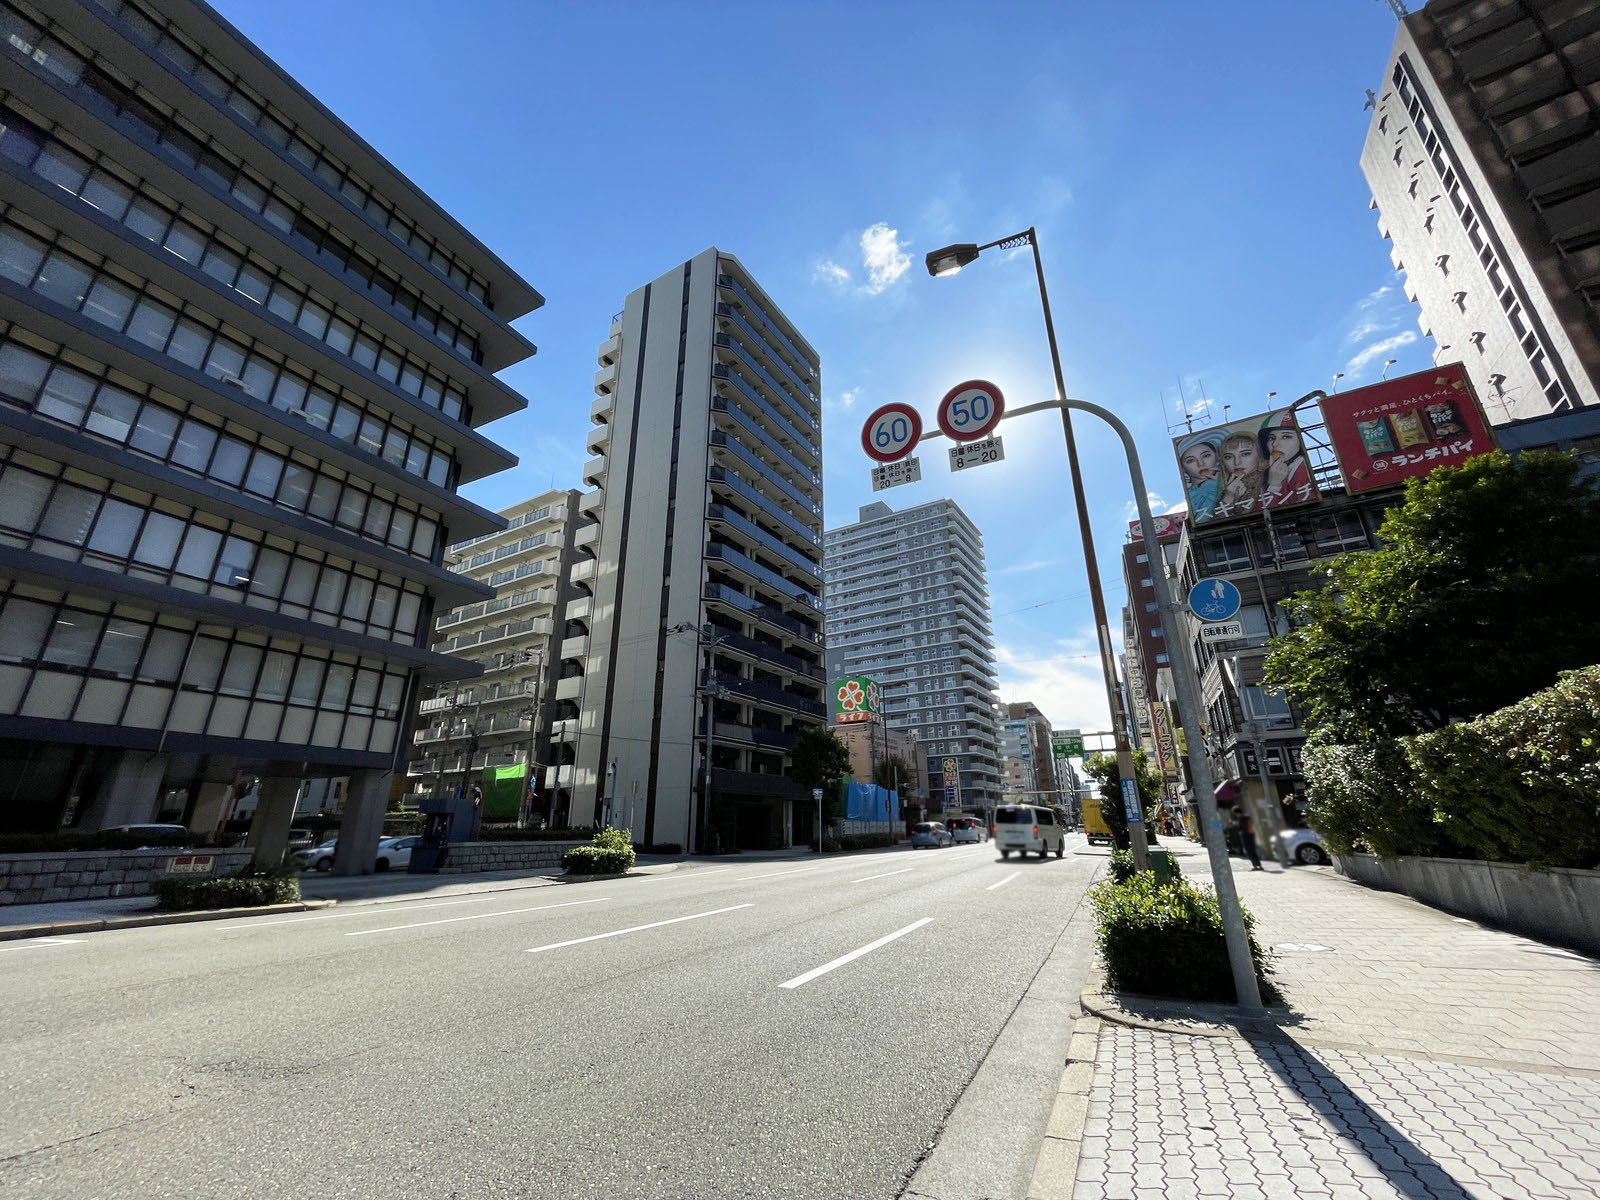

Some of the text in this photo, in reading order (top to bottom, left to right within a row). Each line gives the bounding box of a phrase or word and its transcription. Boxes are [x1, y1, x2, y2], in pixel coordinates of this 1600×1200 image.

[952, 395, 989, 426] 50
[876, 417, 908, 447] 60
[1391, 439, 1474, 467] ランチパイ
[1196, 484, 1315, 521] スキマランチ
[1203, 624, 1241, 637] 自転車通行可
[839, 712, 864, 722] ライフ
[1154, 708, 1174, 762] クリーニング
